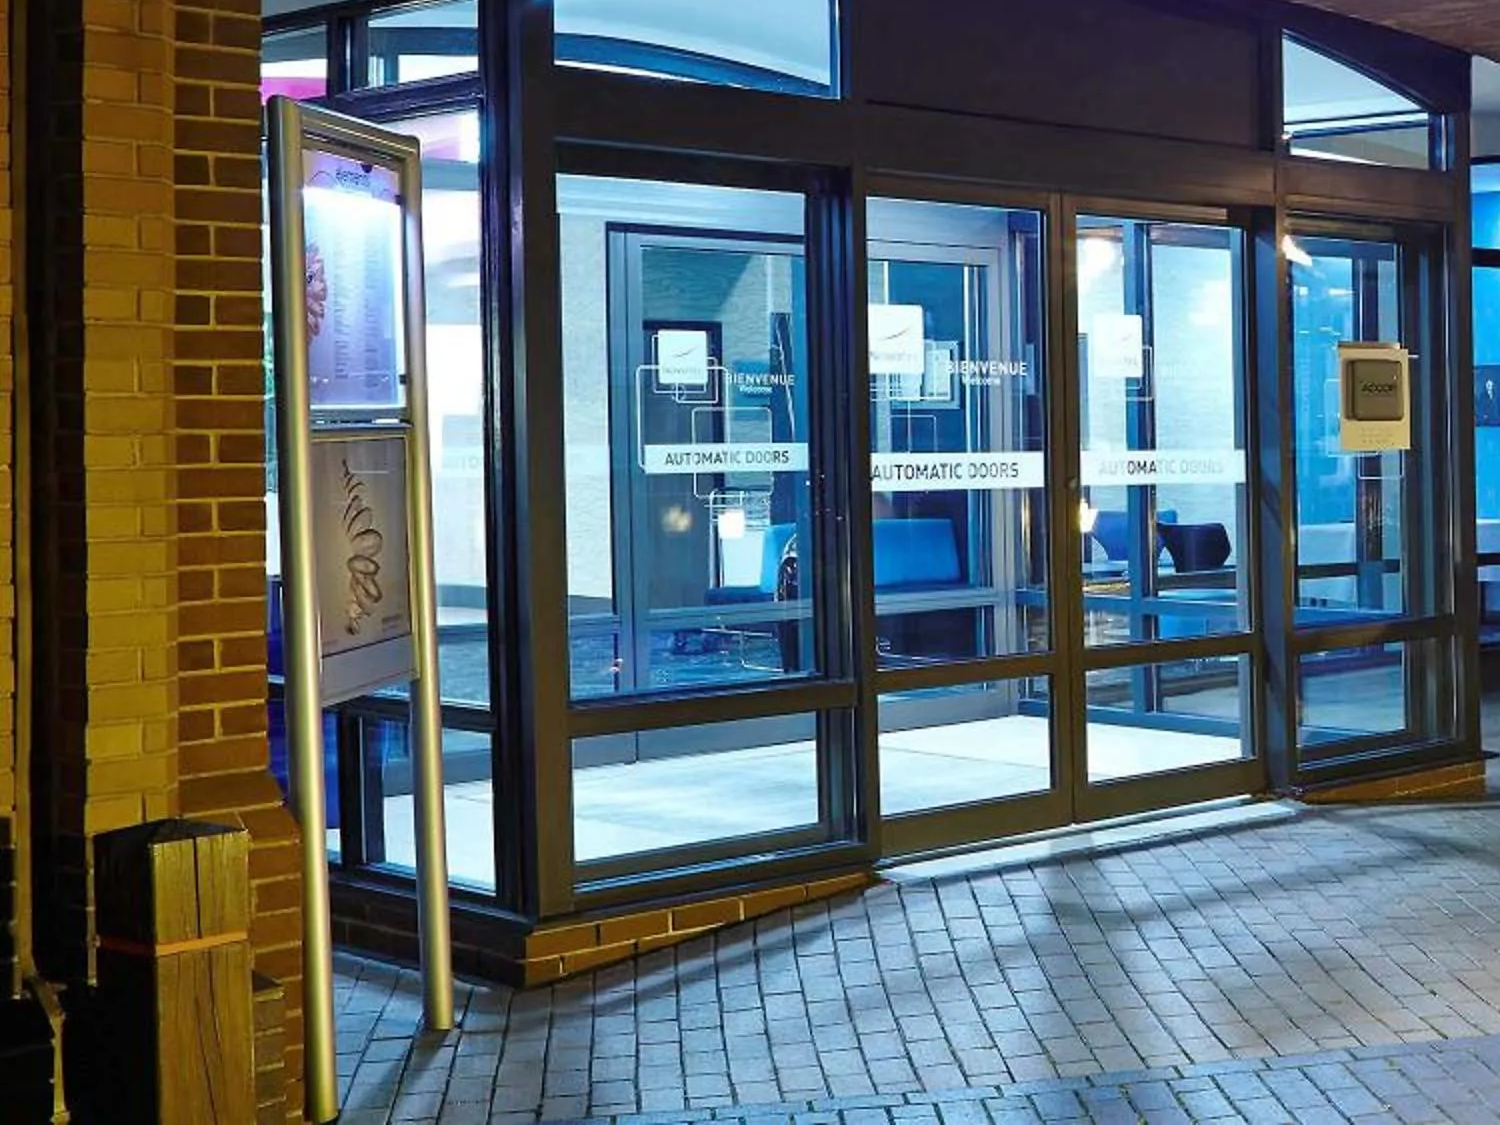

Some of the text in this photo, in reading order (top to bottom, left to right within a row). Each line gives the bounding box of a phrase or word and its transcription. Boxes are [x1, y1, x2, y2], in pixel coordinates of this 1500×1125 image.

[948, 360, 1028, 376] BIENVENUE
[727, 373, 796, 386] BIENVENUE
[664, 450, 790, 466] AUTOMATIC DOORS
[872, 462, 1019, 481] AUTOMATIC DOORS
